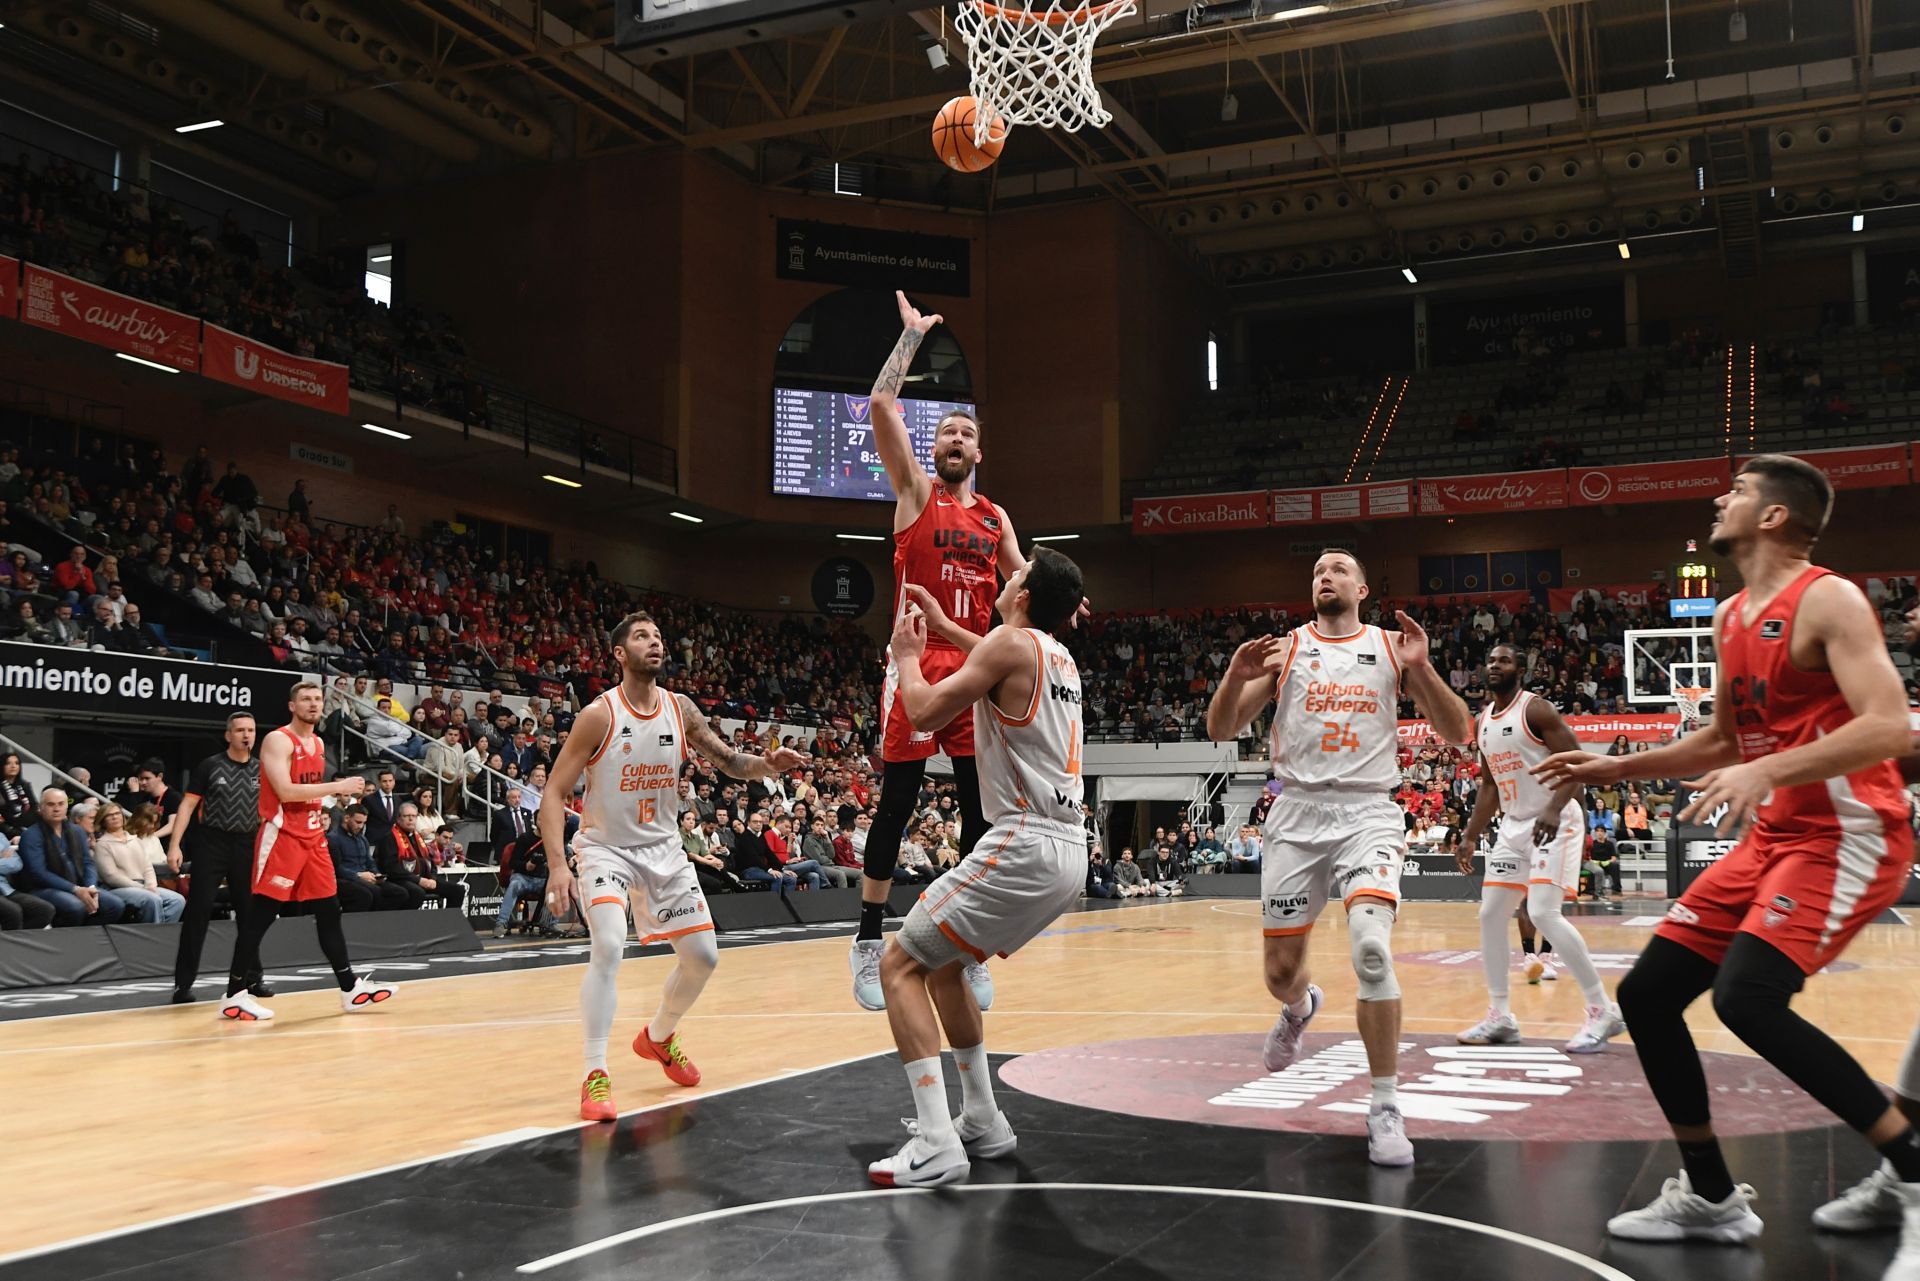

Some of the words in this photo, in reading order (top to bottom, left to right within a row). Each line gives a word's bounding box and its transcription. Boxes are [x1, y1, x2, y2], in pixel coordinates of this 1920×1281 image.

[815, 246, 897, 265] Ayuntamiento
[900, 256, 914, 267] de
[916, 257, 957, 271] Murcia
[848, 430, 866, 446] 27
[861, 451, 882, 464] 8:3
[874, 472, 879, 481] 2
[1463, 480, 1544, 502] aurbús
[1617, 481, 1659, 493] REGIÓN
[1660, 480, 1676, 491] DE
[1677, 477, 1720, 489] MURCIA
[1167, 502, 1259, 525] CaixaBank
[955, 589, 970, 618] 11
[0, 658, 112, 695] miento
[119, 668, 153, 699] de
[162, 671, 252, 707] Murcia
[1307, 680, 1365, 697] Cultura
[1305, 696, 1378, 715] Esfuerzo
[1567, 721, 1676, 733] aquinaria
[1321, 722, 1360, 752] 24
[622, 762, 667, 777] Cultura
[620, 777, 674, 792] Esfuerzo
[1499, 779, 1518, 801] 37
[1490, 861, 1516, 870] PULEVA
[471, 895, 504, 905] Ayuntamie
[1270, 896, 1308, 909] PULEVA
[480, 906, 500, 916] Murci
[667, 905, 695, 920] Midea
[1317, 1046, 1583, 1124] UCAM
